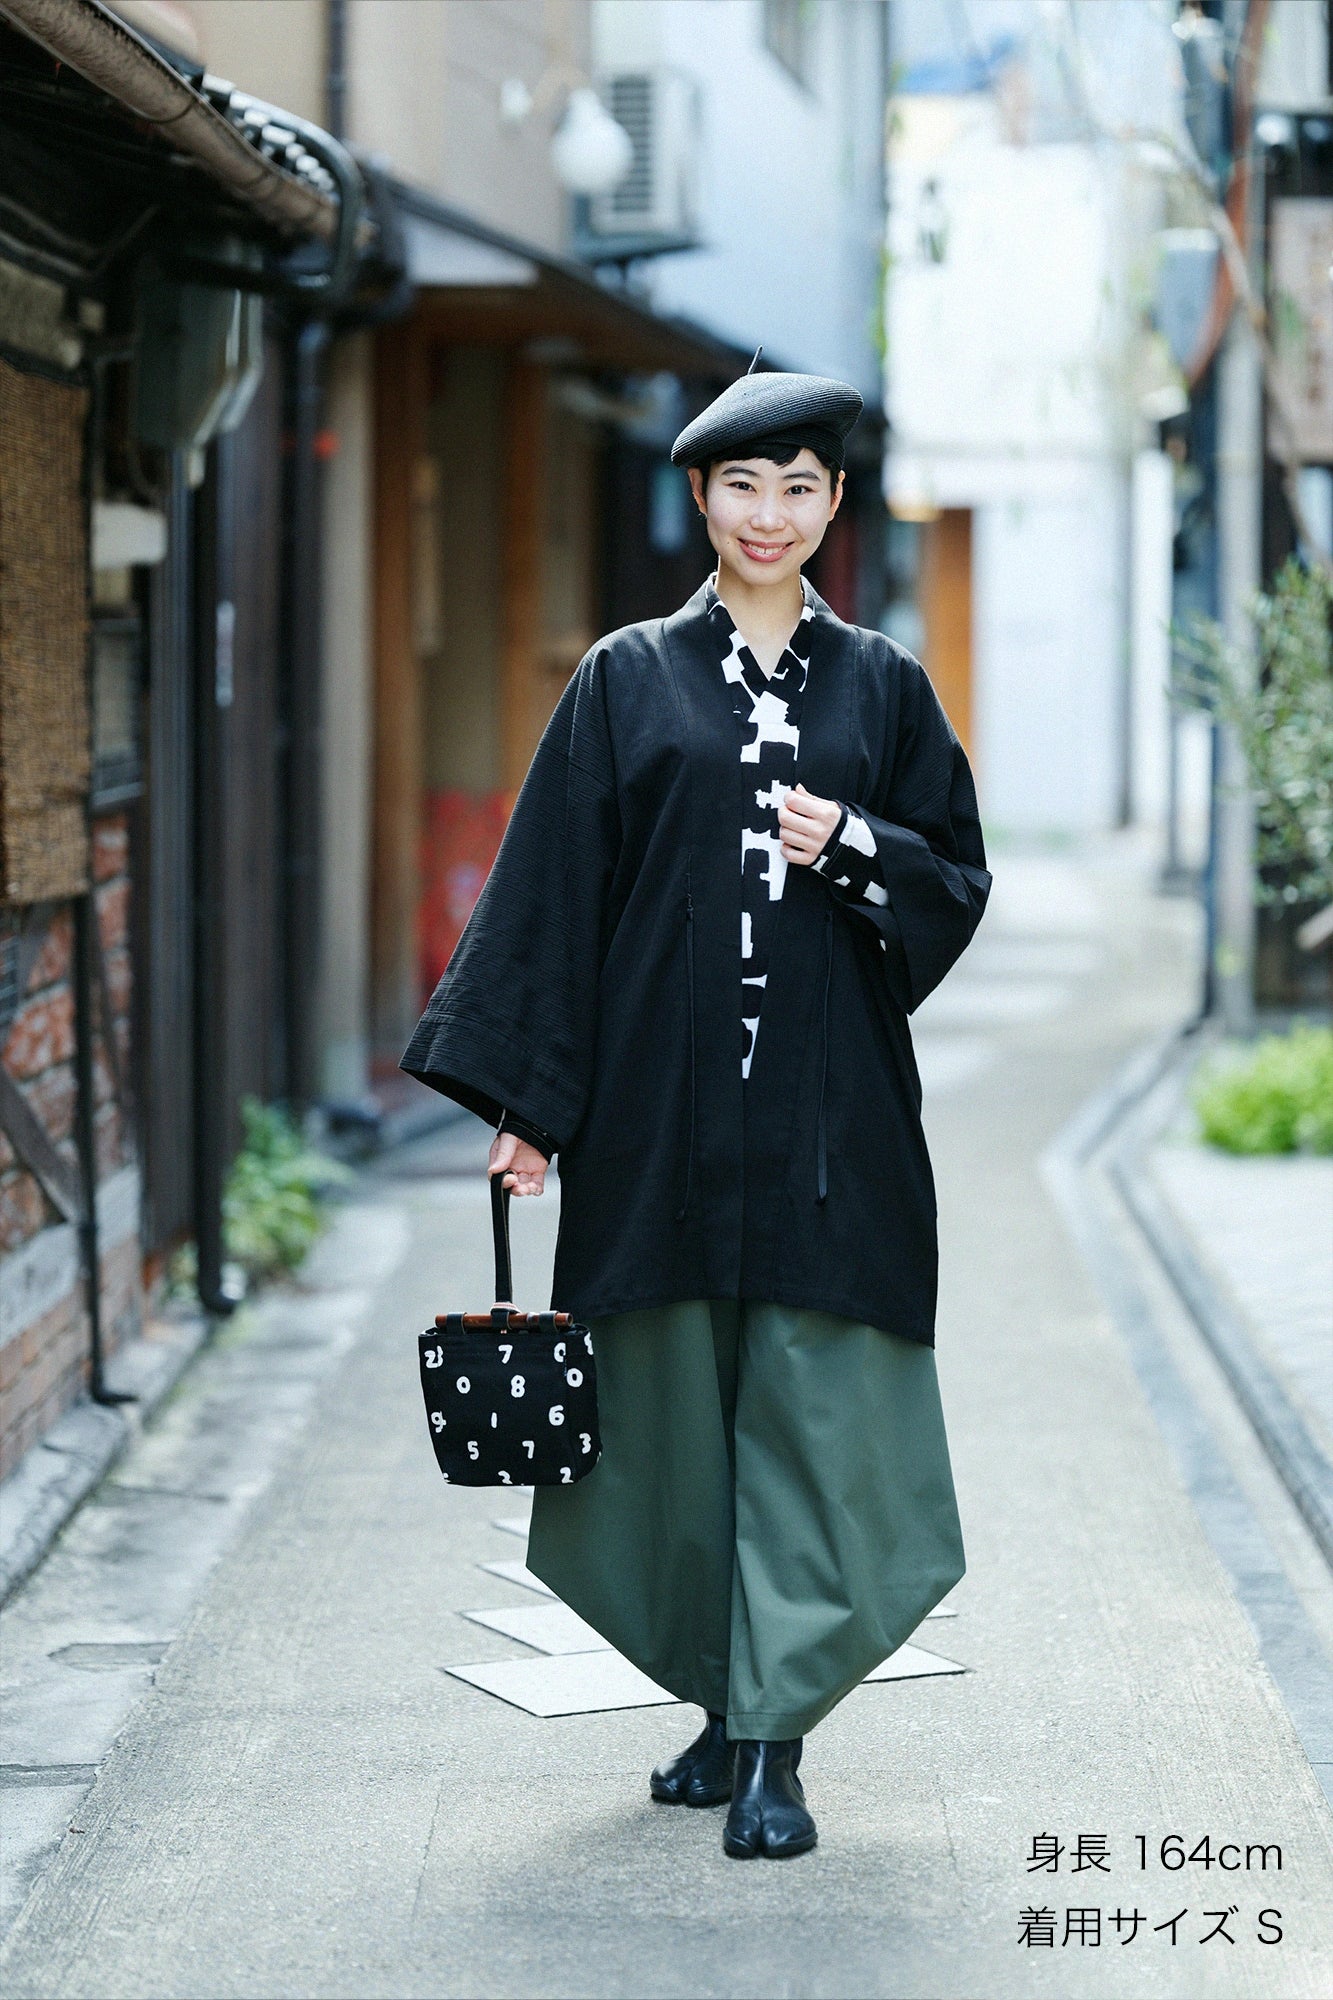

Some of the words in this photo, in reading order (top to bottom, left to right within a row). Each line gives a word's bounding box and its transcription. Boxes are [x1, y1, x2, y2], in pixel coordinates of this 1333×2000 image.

[498, 1344, 514, 1364] 7
[456, 1375, 471, 1394] 0
[510, 1374, 526, 1398] 8
[566, 1367, 584, 1388] 0
[490, 1412, 498, 1429] 1
[548, 1404, 565, 1426] 6
[467, 1440, 480, 1461] 5
[521, 1440, 535, 1460] 7
[579, 1432, 592, 1454] 3
[559, 1466, 574, 1484] 2
